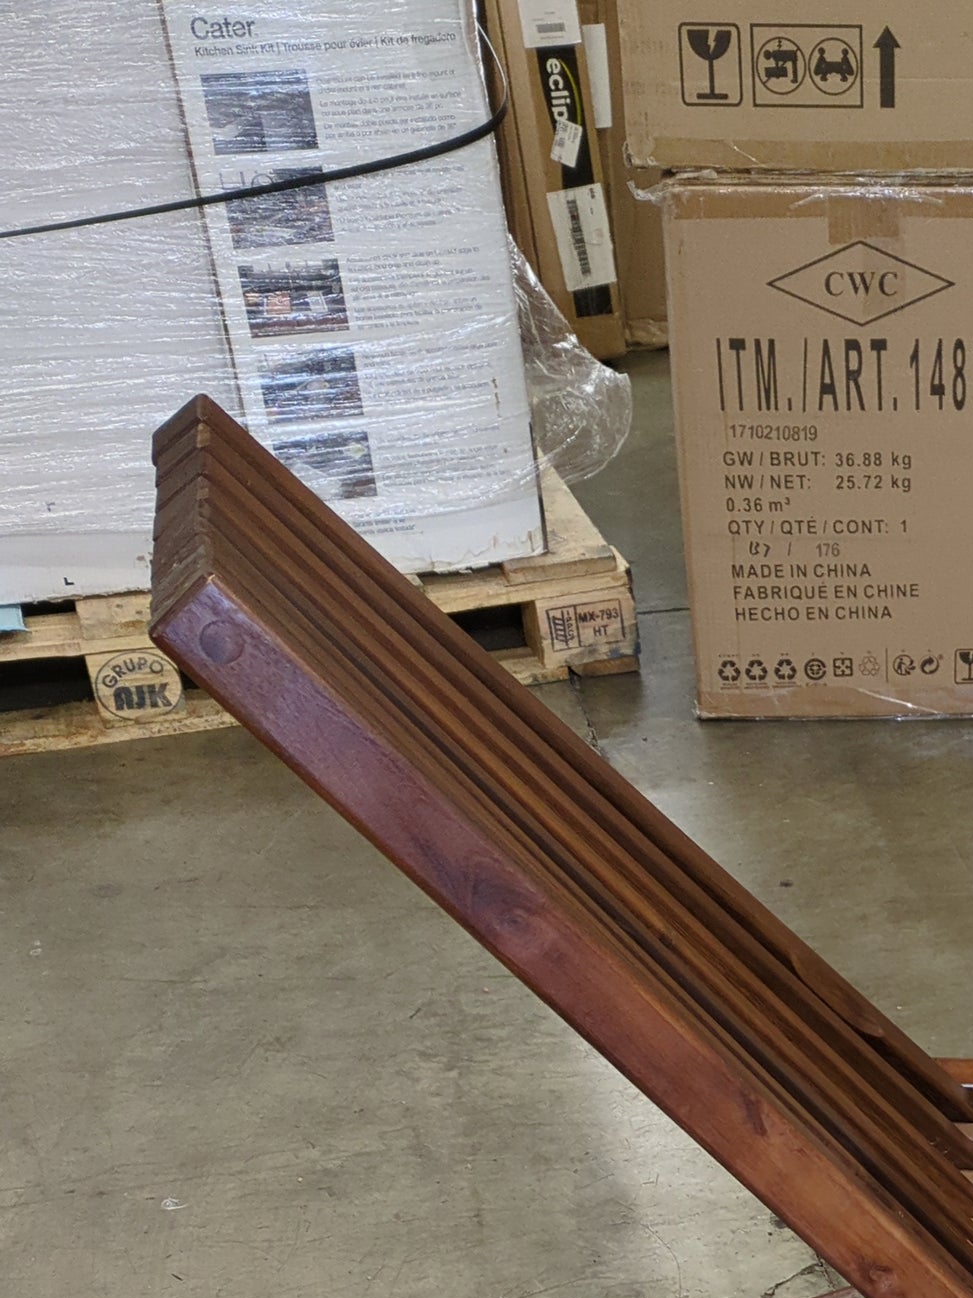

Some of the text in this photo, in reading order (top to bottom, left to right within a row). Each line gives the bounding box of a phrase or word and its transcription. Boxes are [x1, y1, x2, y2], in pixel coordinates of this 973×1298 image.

[190, 17, 256, 40] Cater
[194, 45, 234, 57] Kitchen
[260, 43, 275, 53] Kit
[283, 40, 322, 52] Trousse
[324, 39, 347, 52] pour
[380, 37, 395, 47] Kit
[546, 58, 571, 122] eclip
[823, 271, 899, 298] CWC
[729, 424, 819, 442] 1710210819
[722, 451, 754, 468] GW
[769, 451, 826, 468] BRUT:
[834, 452, 883, 468] 36.88
[891, 451, 912, 470] kg
[724, 474, 754, 490] NW
[770, 474, 812, 490] NET:
[835, 474, 883, 490] 25.72
[891, 474, 912, 493] kg
[725, 497, 763, 513] 0.36
[727, 519, 765, 536] QTY
[832, 519, 889, 535] CONT:
[900, 519, 908, 534] 1
[815, 542, 841, 558] 176
[731, 563, 872, 579] MADE IN CHINA
[733, 581, 920, 601] FABRIQUÉ EN CHINE
[578, 607, 620, 624] MX-793
[735, 605, 893, 622] HECHO EN CHINA
[593, 624, 609, 637] HT
[102, 656, 165, 689] GRUPO
